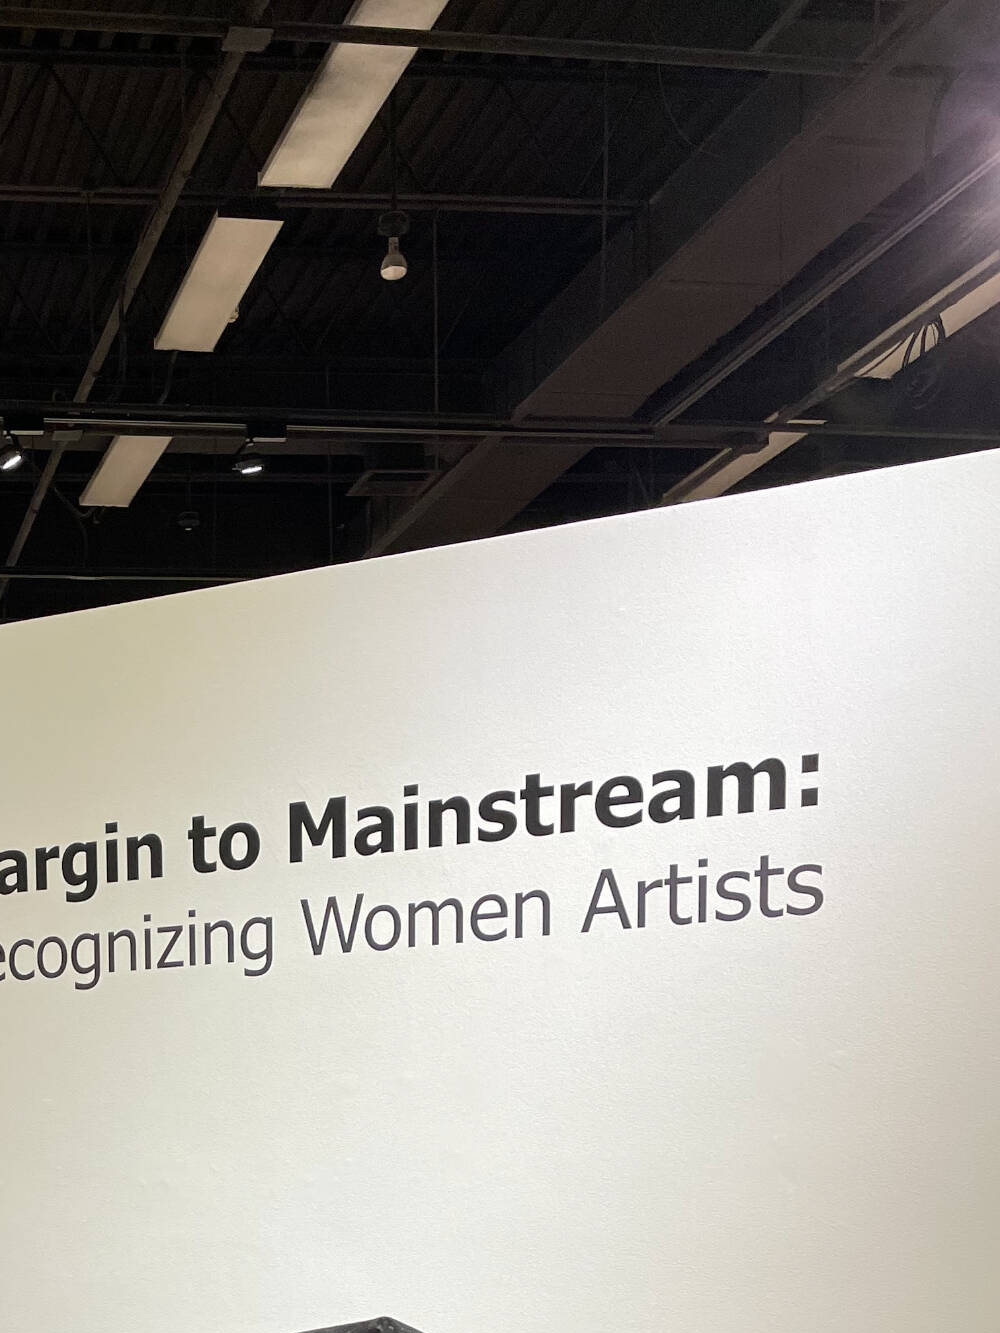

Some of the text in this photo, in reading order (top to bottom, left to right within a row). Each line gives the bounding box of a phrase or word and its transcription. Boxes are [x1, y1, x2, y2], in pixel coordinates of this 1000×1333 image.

[187, 815, 261, 874] to
[289, 753, 819, 864] Mainstream:
[300, 883, 550, 956] Women
[580, 855, 824, 933] Artists
